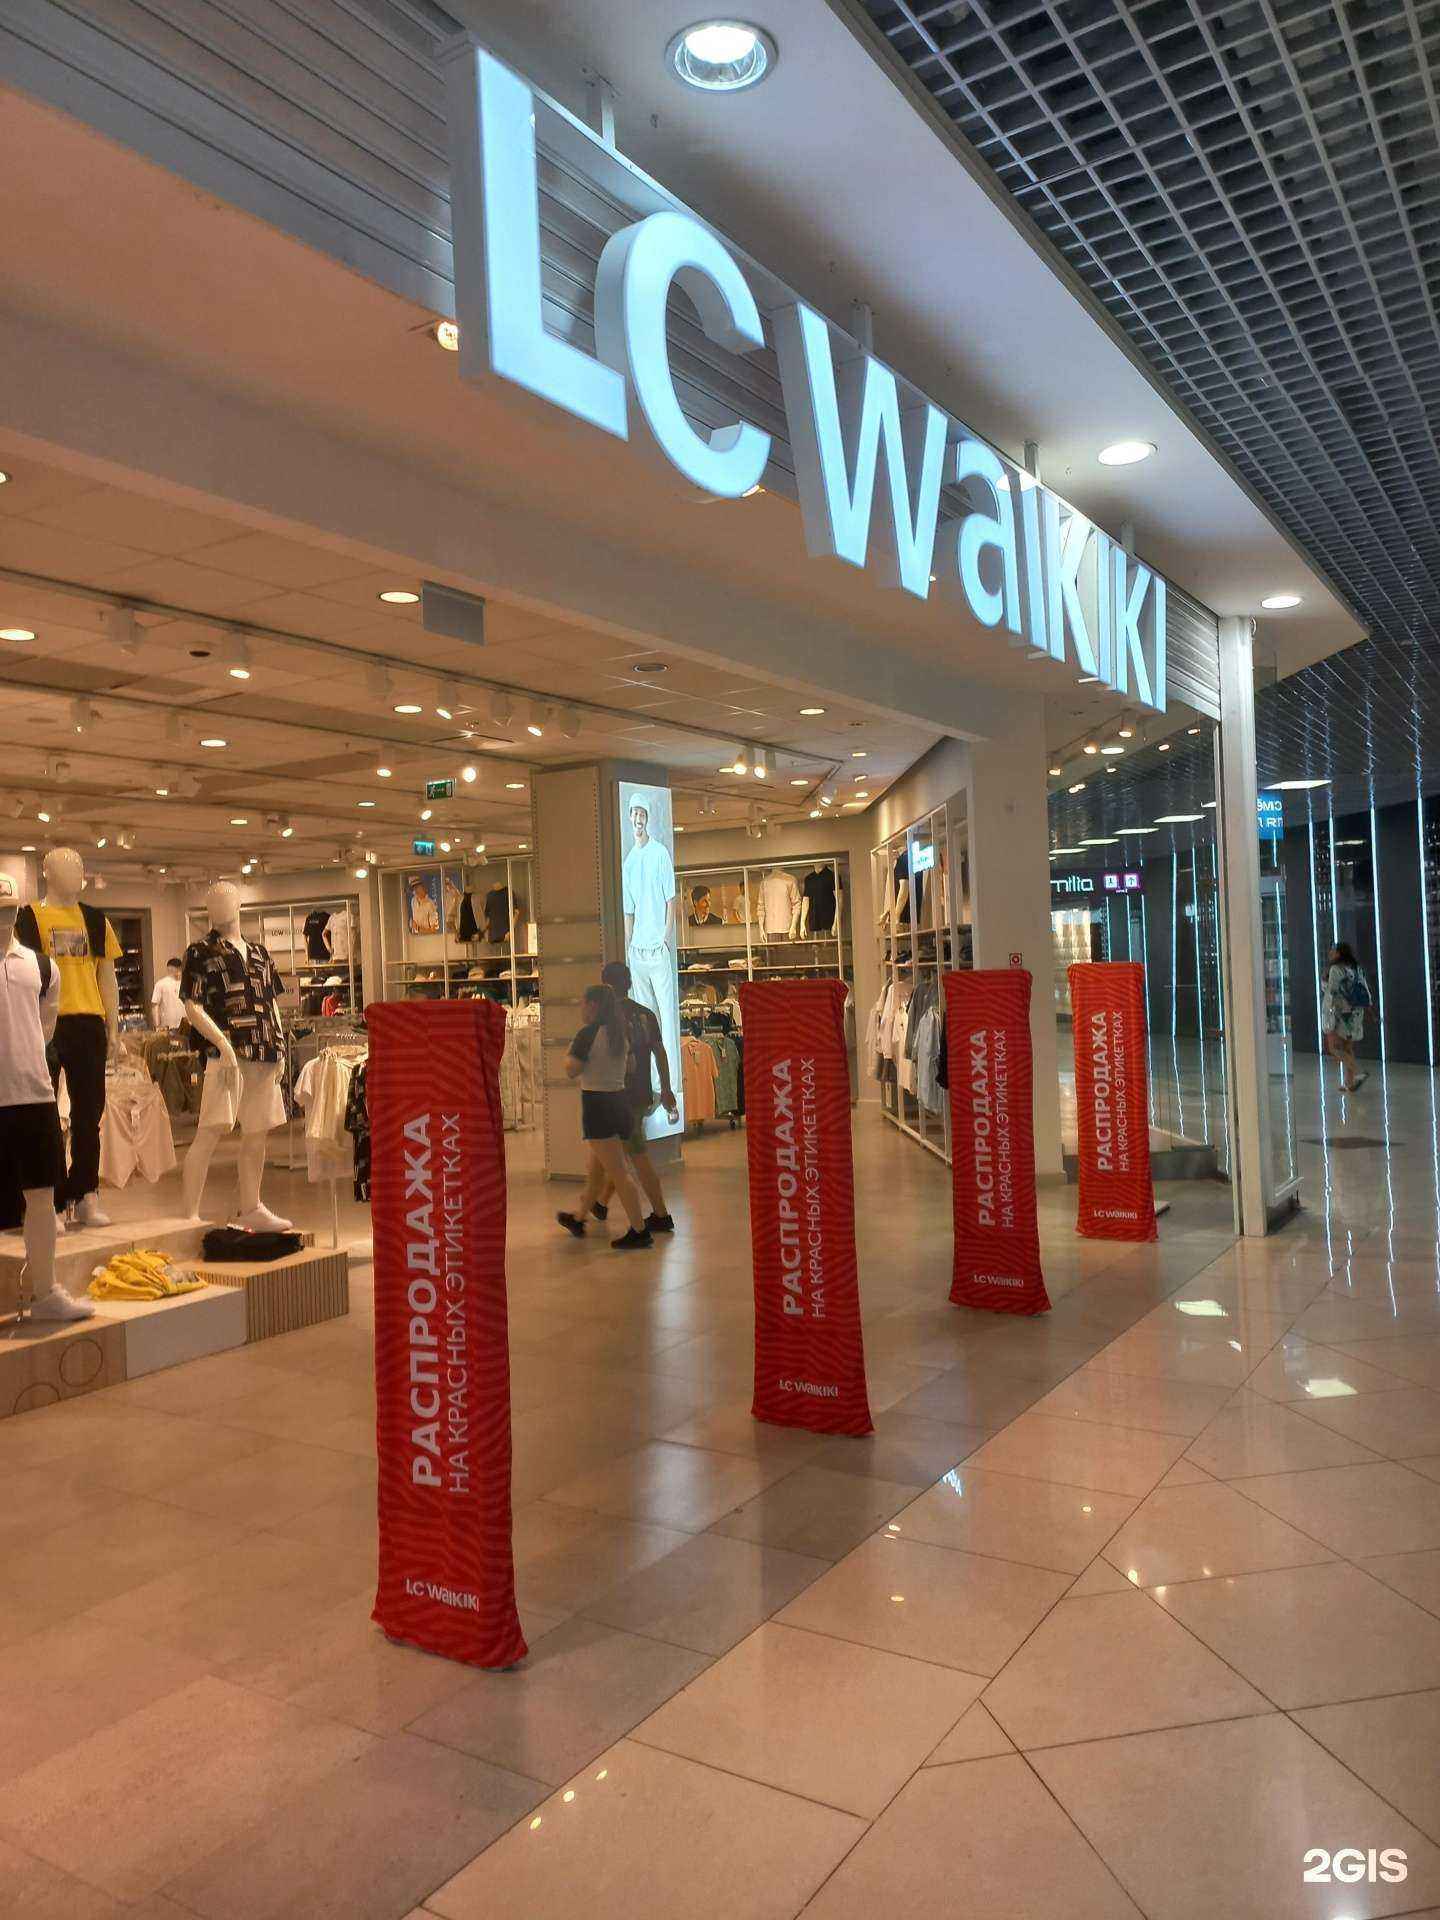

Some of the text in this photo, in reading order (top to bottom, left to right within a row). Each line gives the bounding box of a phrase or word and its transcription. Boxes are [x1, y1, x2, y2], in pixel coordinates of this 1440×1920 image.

[477, 47, 770, 498] LC
[773, 1059, 804, 1317] РАСПРОДАЖА
[800, 1057, 827, 1320] НА КРАСНЫХ ЭТИКЕТКАХ
[970, 1029, 996, 1227] РАСПРОДАЖА
[993, 1029, 1014, 1228] НА КРАСНЫХ ЭТИКЕТКАХ
[1091, 1011, 1113, 1171] РАСПРОДАЖА
[1112, 1010, 1130, 1172] НА КРАСНЫХ ЭТИКЕТКАХ
[402, 1114, 442, 1488] РАСПРОДАЖА
[441, 1112, 470, 1493] НА КРАСНЫХ ЭТИКЕТКАХ
